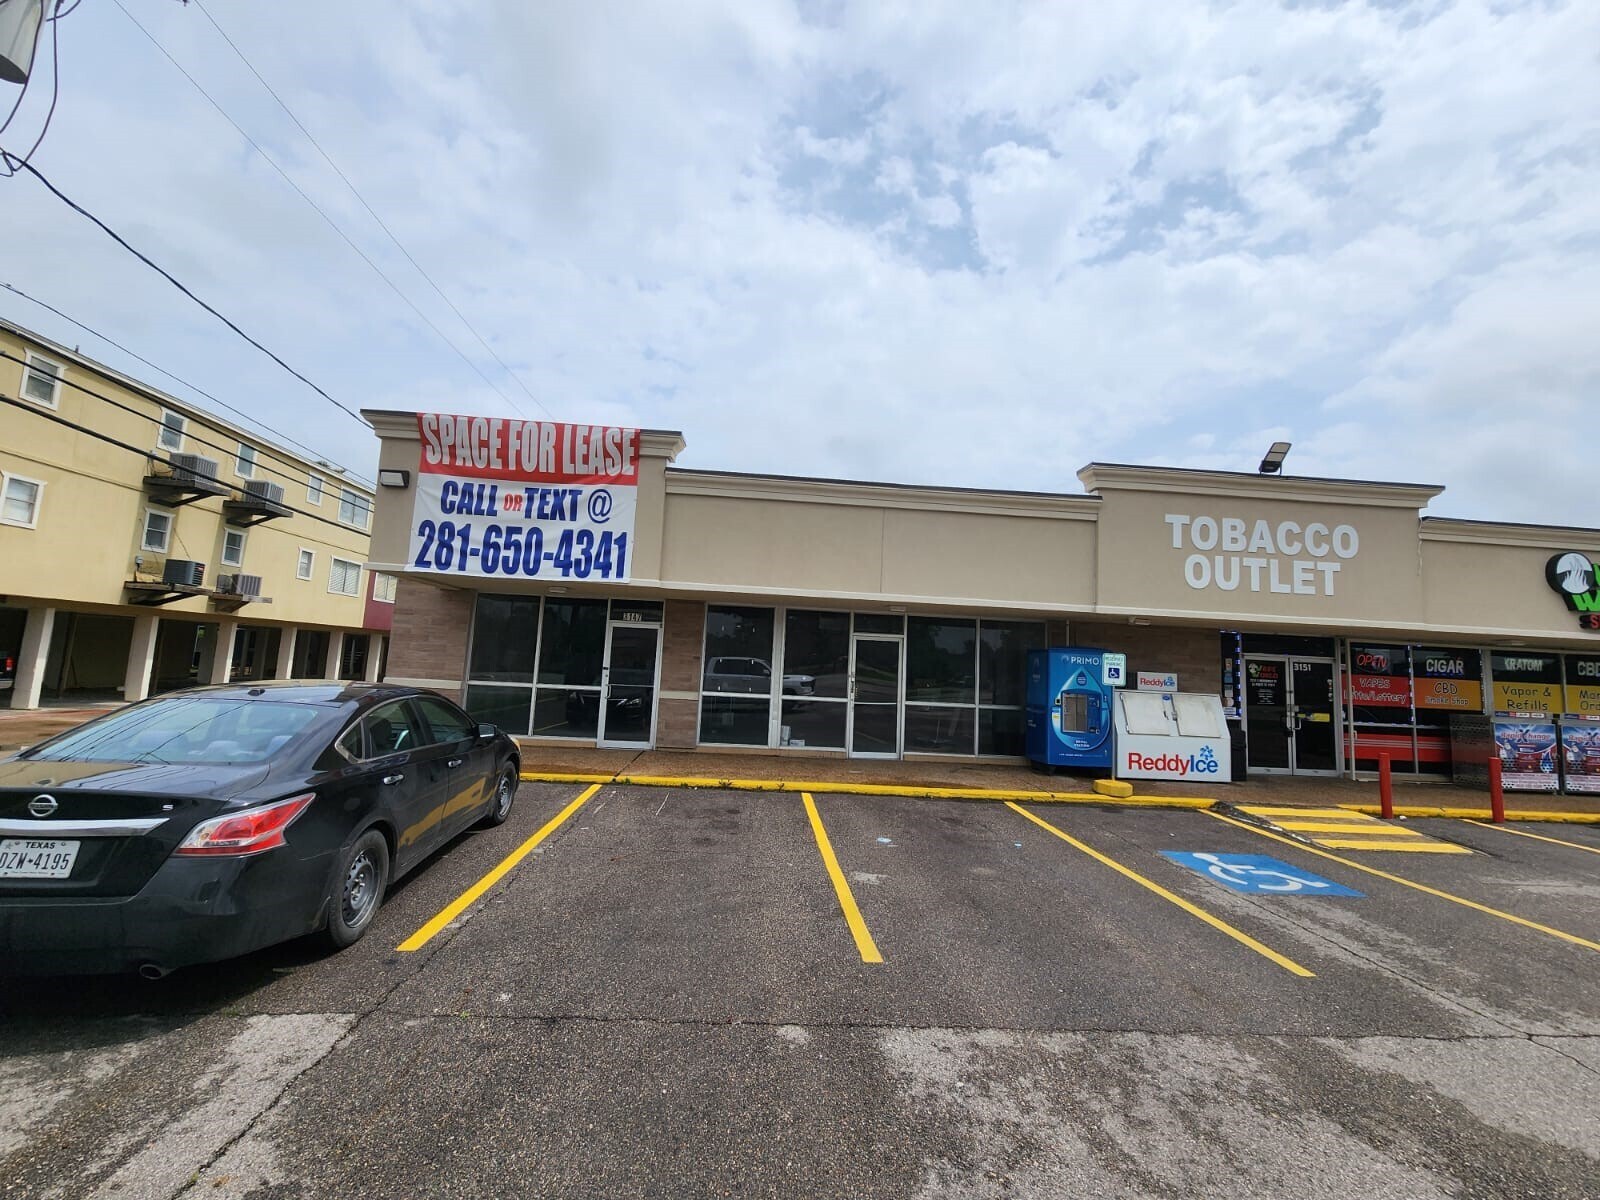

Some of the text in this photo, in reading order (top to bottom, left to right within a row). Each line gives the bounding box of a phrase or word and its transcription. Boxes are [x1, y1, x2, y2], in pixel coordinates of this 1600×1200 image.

[421, 413, 635, 476] SPACE FOR LEASE
[440, 480, 613, 524] CALL OR TEXT @
[1164, 513, 1360, 559] TOBACCO
[414, 519, 628, 579] 281-650-4341
[1184, 553, 1341, 596] OUTLET
[1070, 656, 1100, 666] PRIMO
[1293, 663, 1311, 672] 3151
[1357, 654, 1388, 669] OPEN
[1426, 659, 1464, 674] CIGAR
[1504, 657, 1543, 672] KRATOM
[1360, 677, 1391, 688] VAPES
[1434, 682, 1458, 695] CBD
[1502, 686, 1538, 697] Vapor
[1451, 696, 1469, 705] Shop
[1507, 699, 1548, 711] Refills
